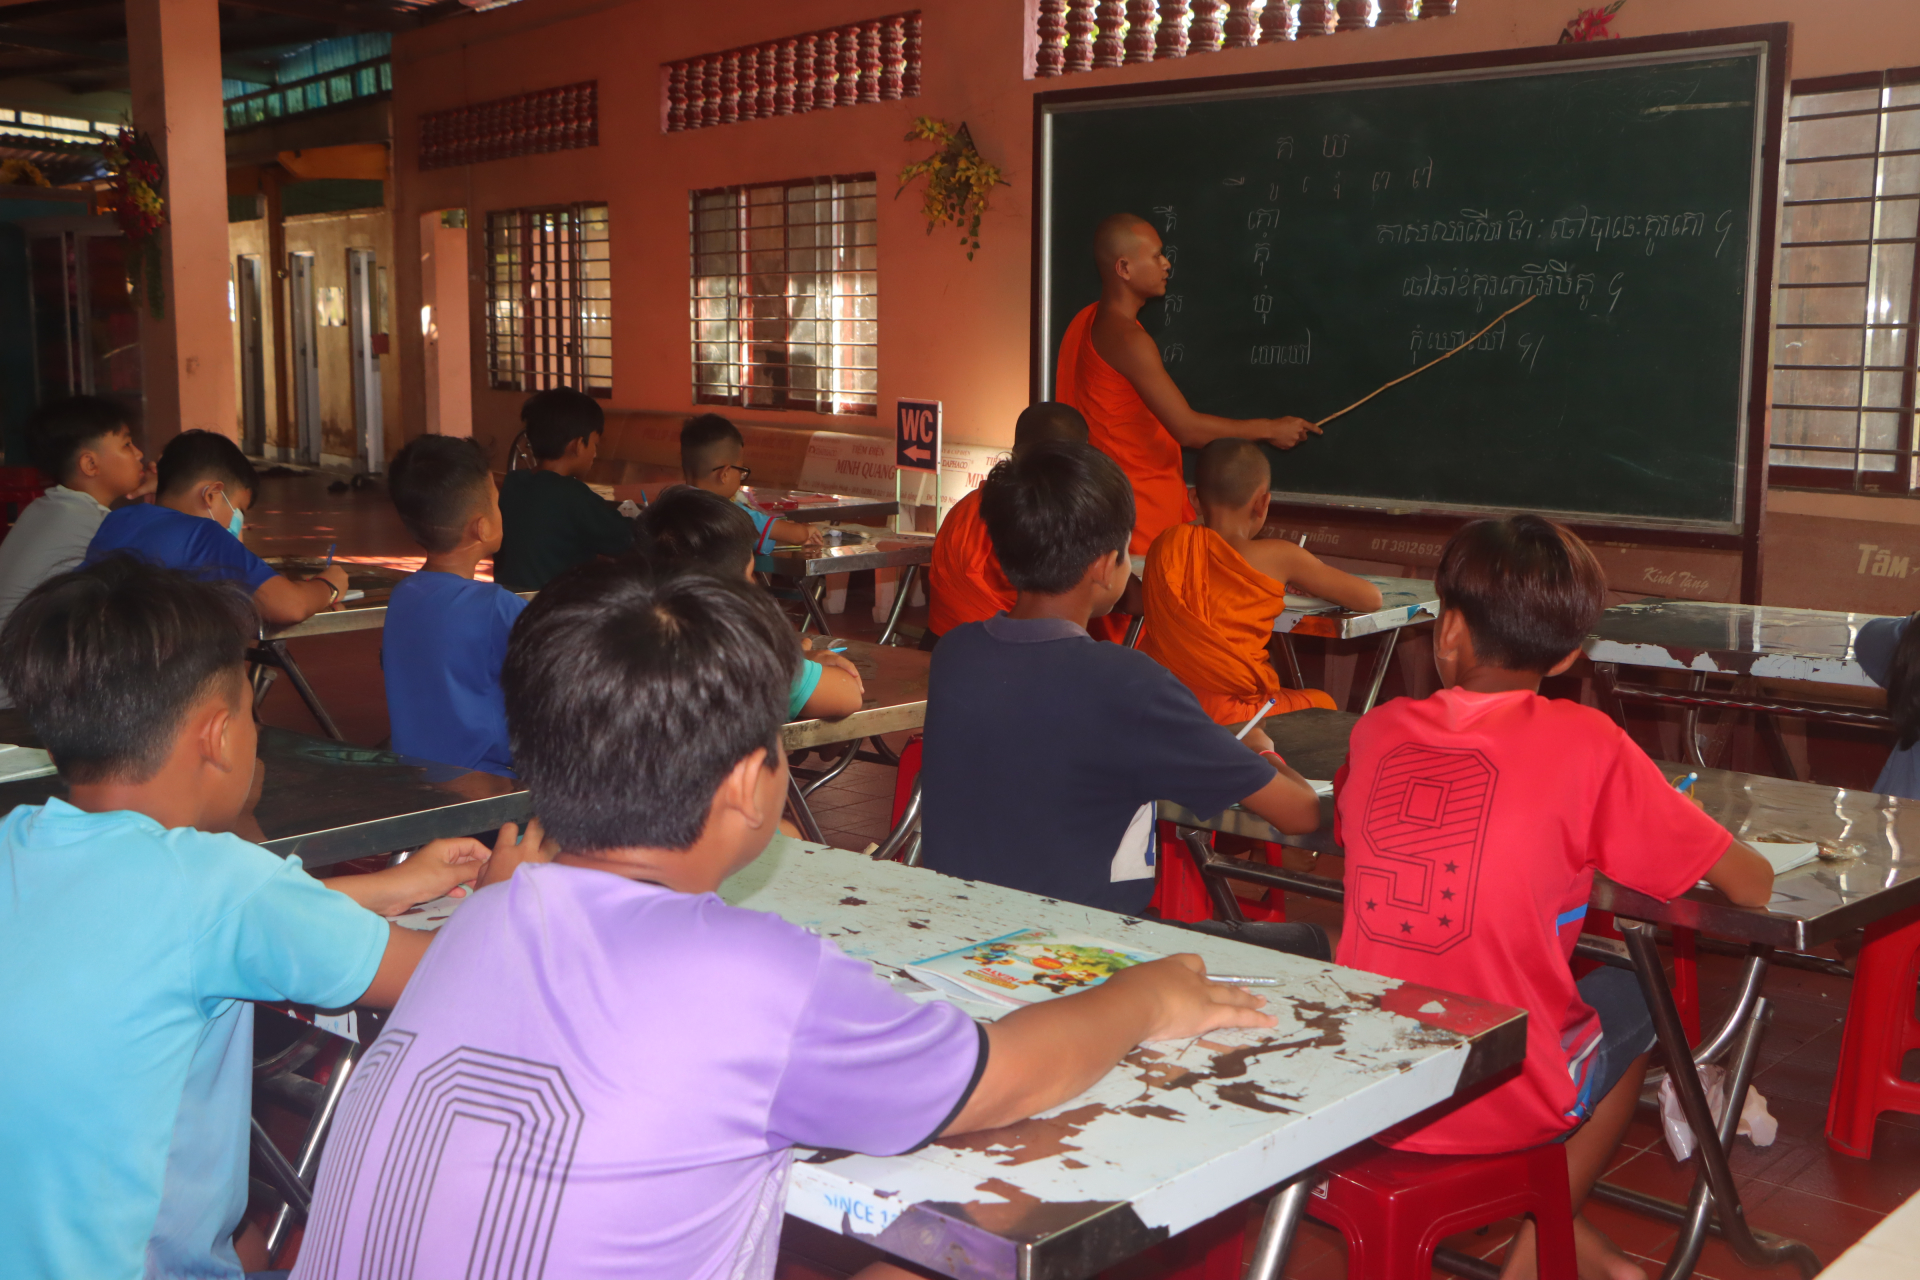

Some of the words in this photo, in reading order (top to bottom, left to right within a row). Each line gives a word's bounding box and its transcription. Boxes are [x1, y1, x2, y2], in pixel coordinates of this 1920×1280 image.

[901, 408, 934, 444] WC
[835, 459, 861, 476] MINH
[862, 462, 896, 480] QUANG
[1389, 540, 1443, 557] 3812692
[1679, 572, 1710, 594] Tặng
[1353, 741, 1499, 955] 9
